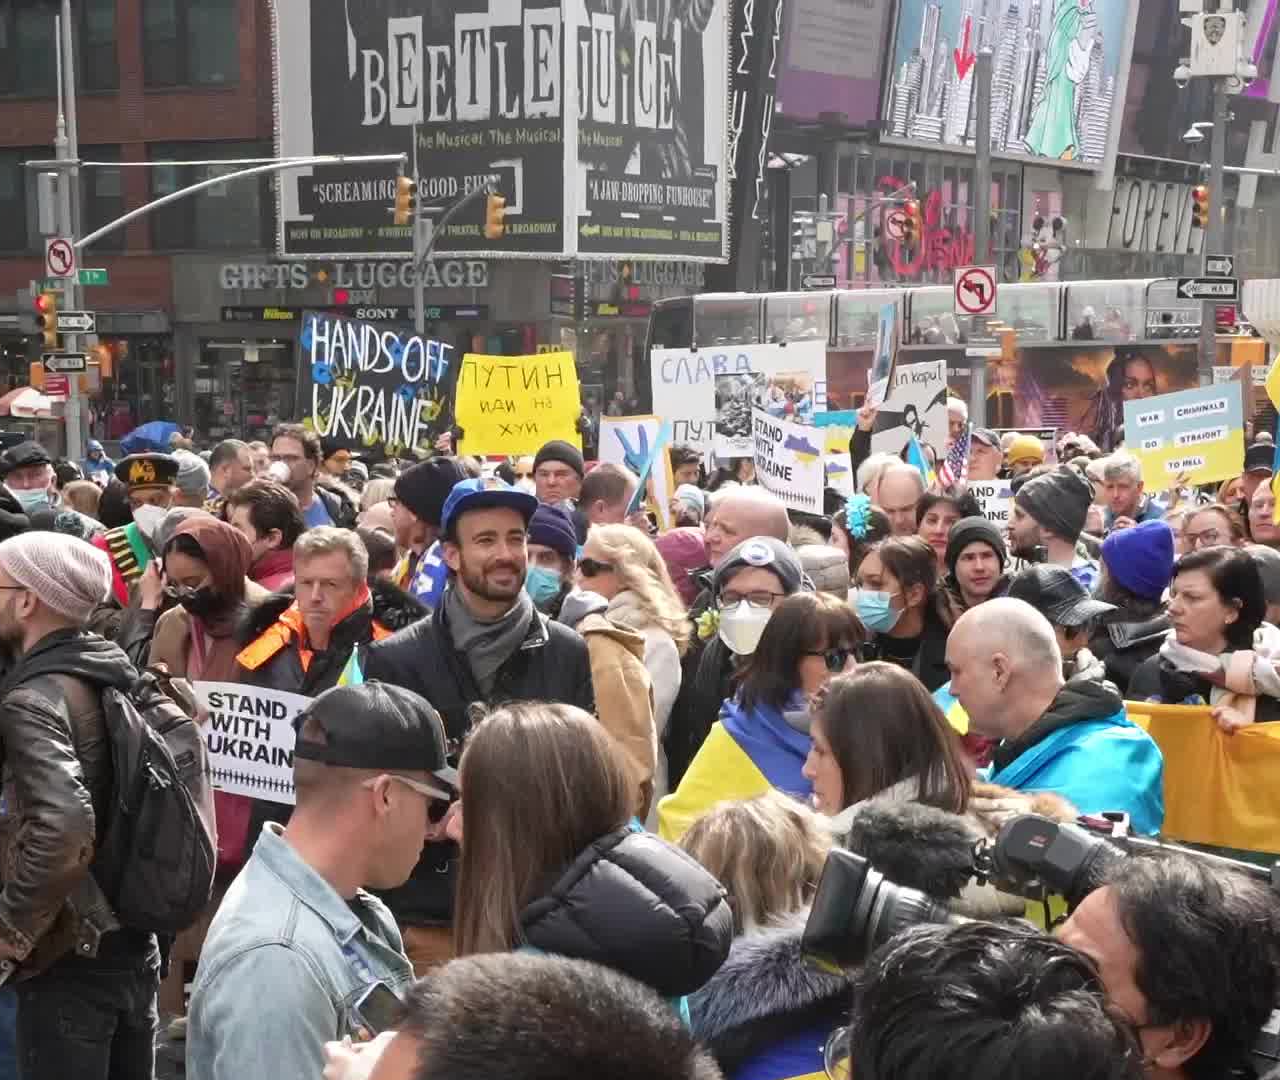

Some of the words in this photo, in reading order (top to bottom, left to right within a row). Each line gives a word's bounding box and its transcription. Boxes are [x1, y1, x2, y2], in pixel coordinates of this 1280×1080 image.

[313, 175, 396, 202] "SCREAMING
[221, 264, 308, 289] GIFTS
[335, 261, 488, 289] LUGGAGE
[355, 308, 398, 319] SONY
[311, 316, 401, 374] HANDS
[401, 336, 454, 383] OFF
[461, 361, 563, 389] ПУТИН
[312, 383, 433, 450] UKRAINE
[1140, 414, 1159, 423] WAR
[1176, 401, 1225, 417] CRIMINALS
[1183, 458, 1203, 467] HELL
[208, 691, 287, 719] STAND
[211, 711, 271, 741] WITH
[207, 733, 296, 768] UKRAIN
